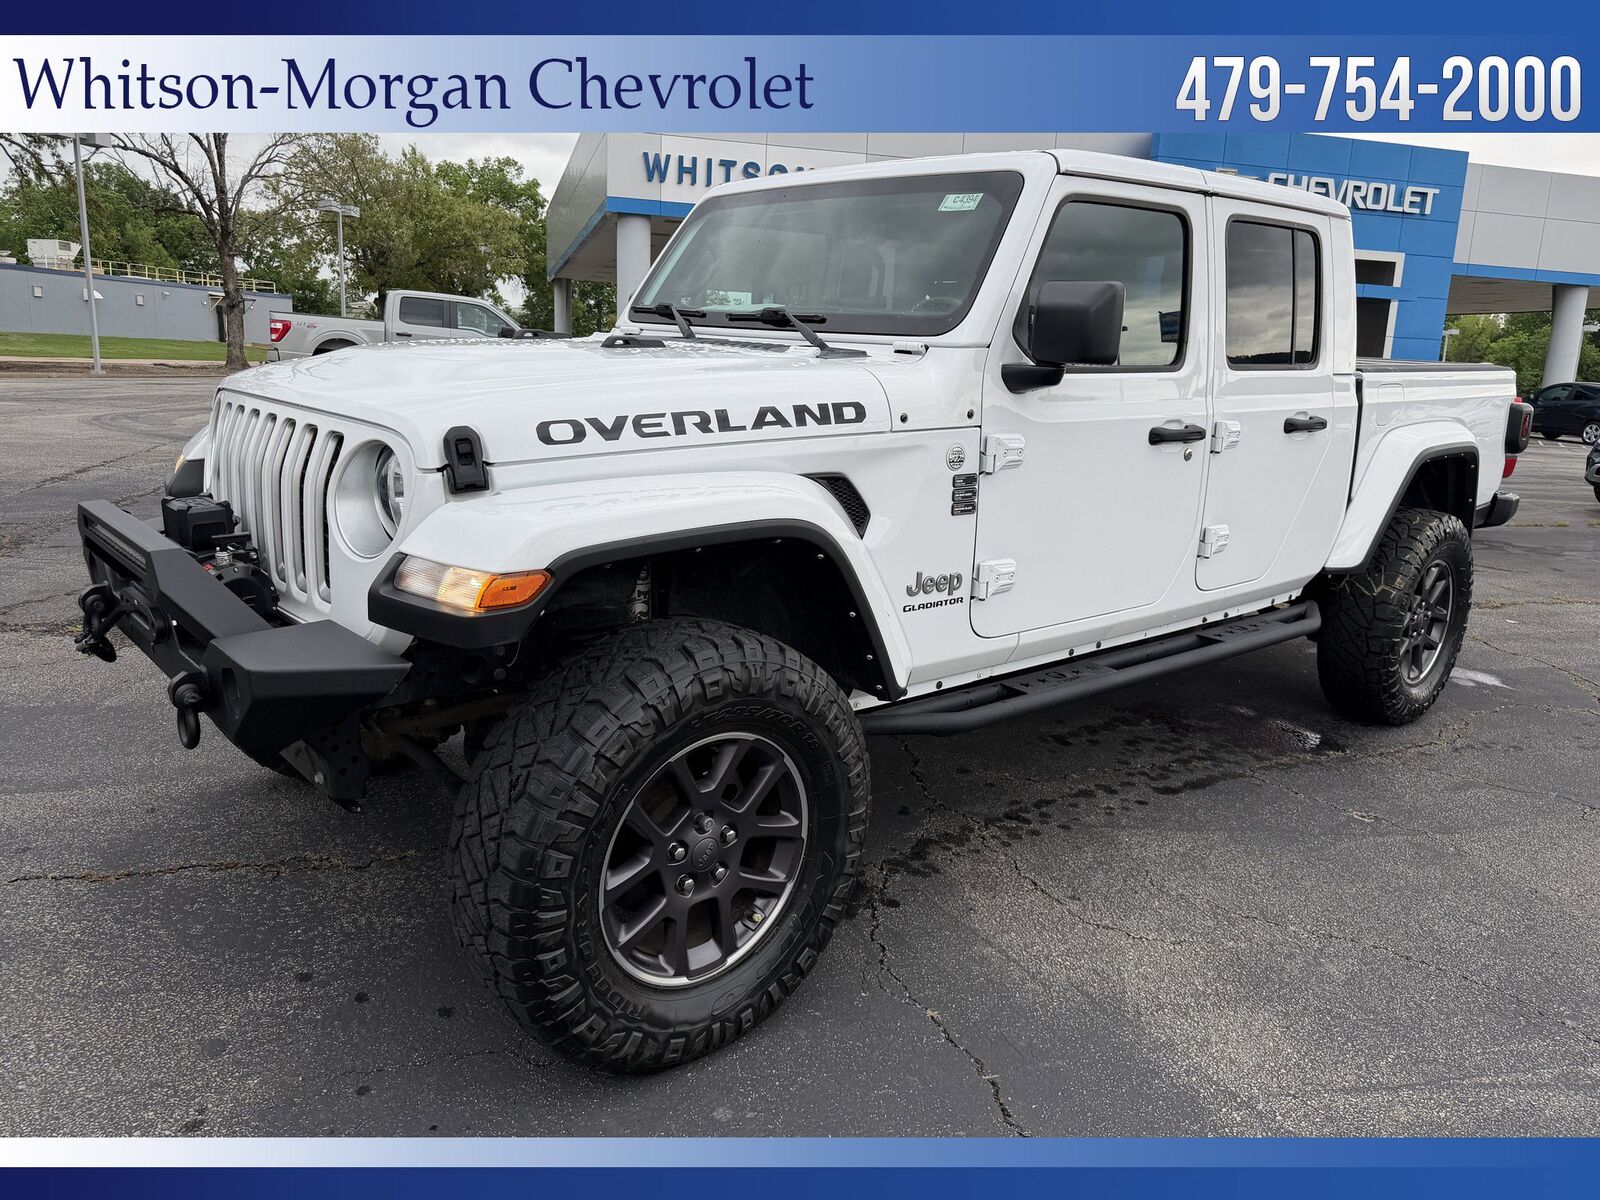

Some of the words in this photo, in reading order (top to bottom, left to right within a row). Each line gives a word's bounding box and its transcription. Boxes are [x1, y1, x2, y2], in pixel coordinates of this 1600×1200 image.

[643, 151, 816, 187] WHITS
[536, 401, 867, 446] OVERLAND
[906, 571, 963, 597] Jeep
[902, 596, 964, 613] GLADIATOR
